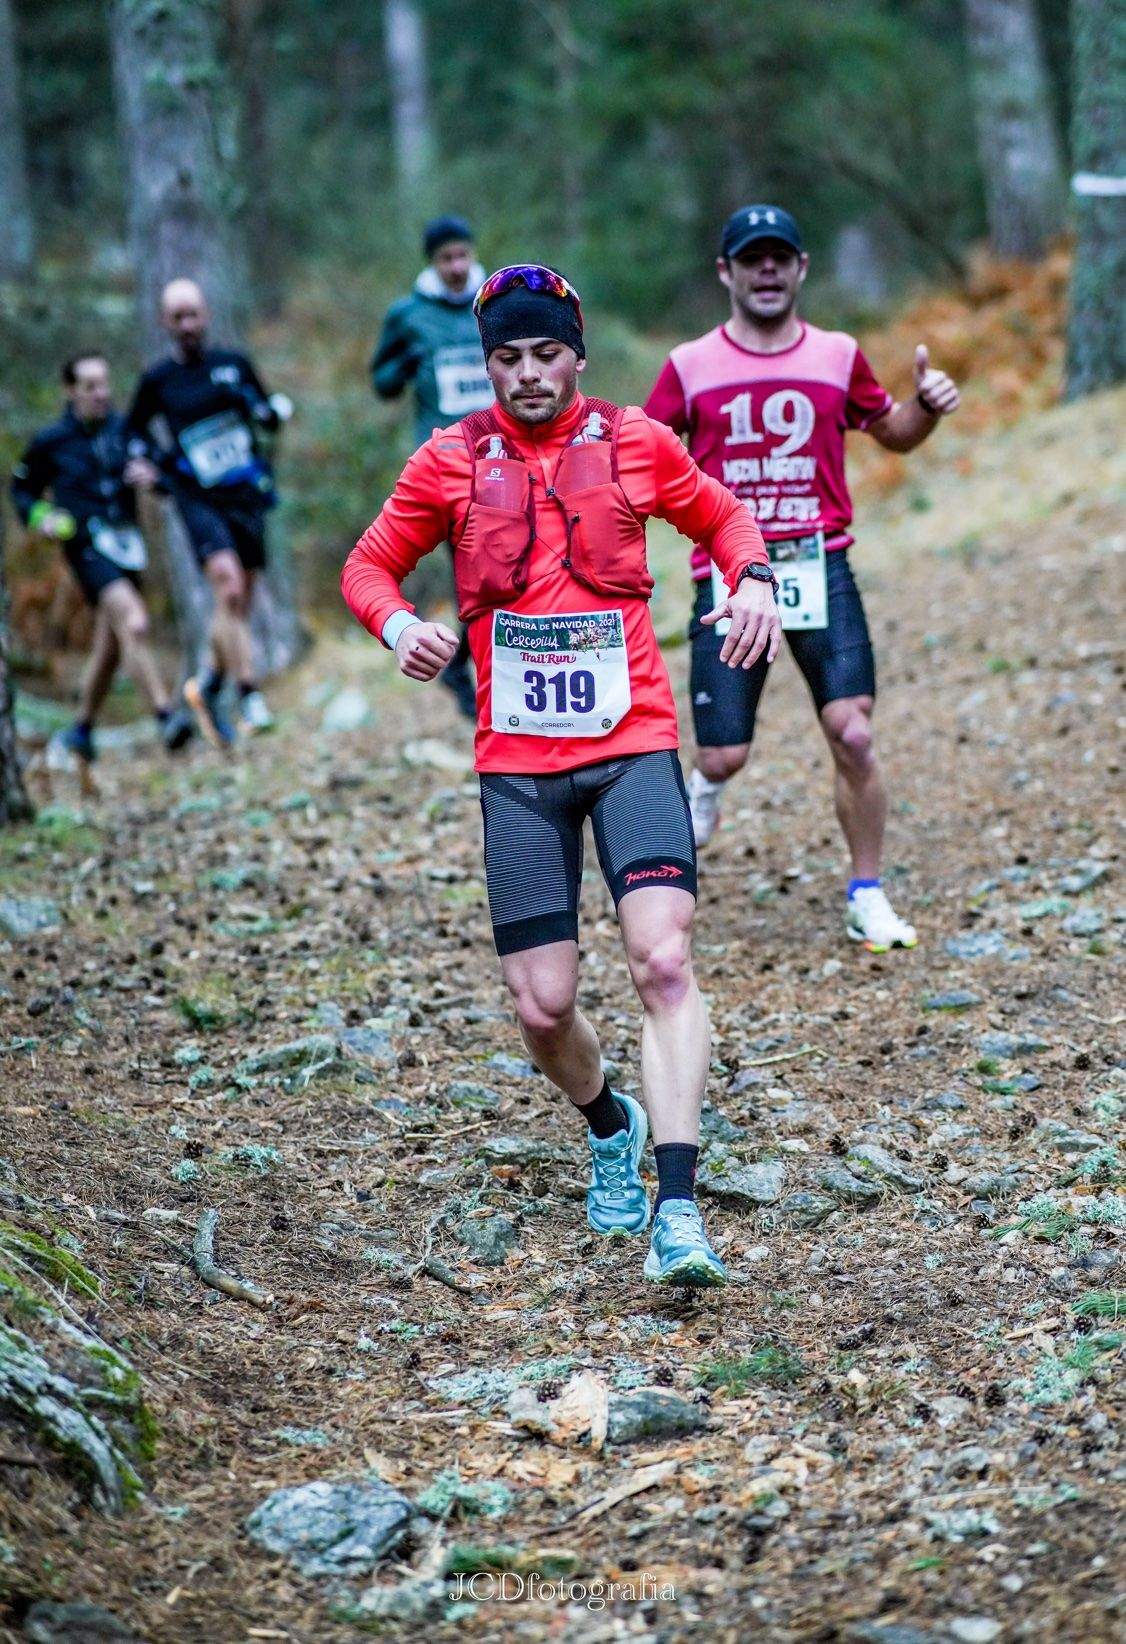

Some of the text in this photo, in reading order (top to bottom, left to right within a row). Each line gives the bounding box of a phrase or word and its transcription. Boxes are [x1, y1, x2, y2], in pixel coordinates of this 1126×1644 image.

[718, 388, 816, 459] 19
[499, 617, 538, 631] CARRERA
[552, 619, 596, 629] NAVIDAD
[519, 651, 576, 665] Trail Run
[523, 670, 596, 713] 319
